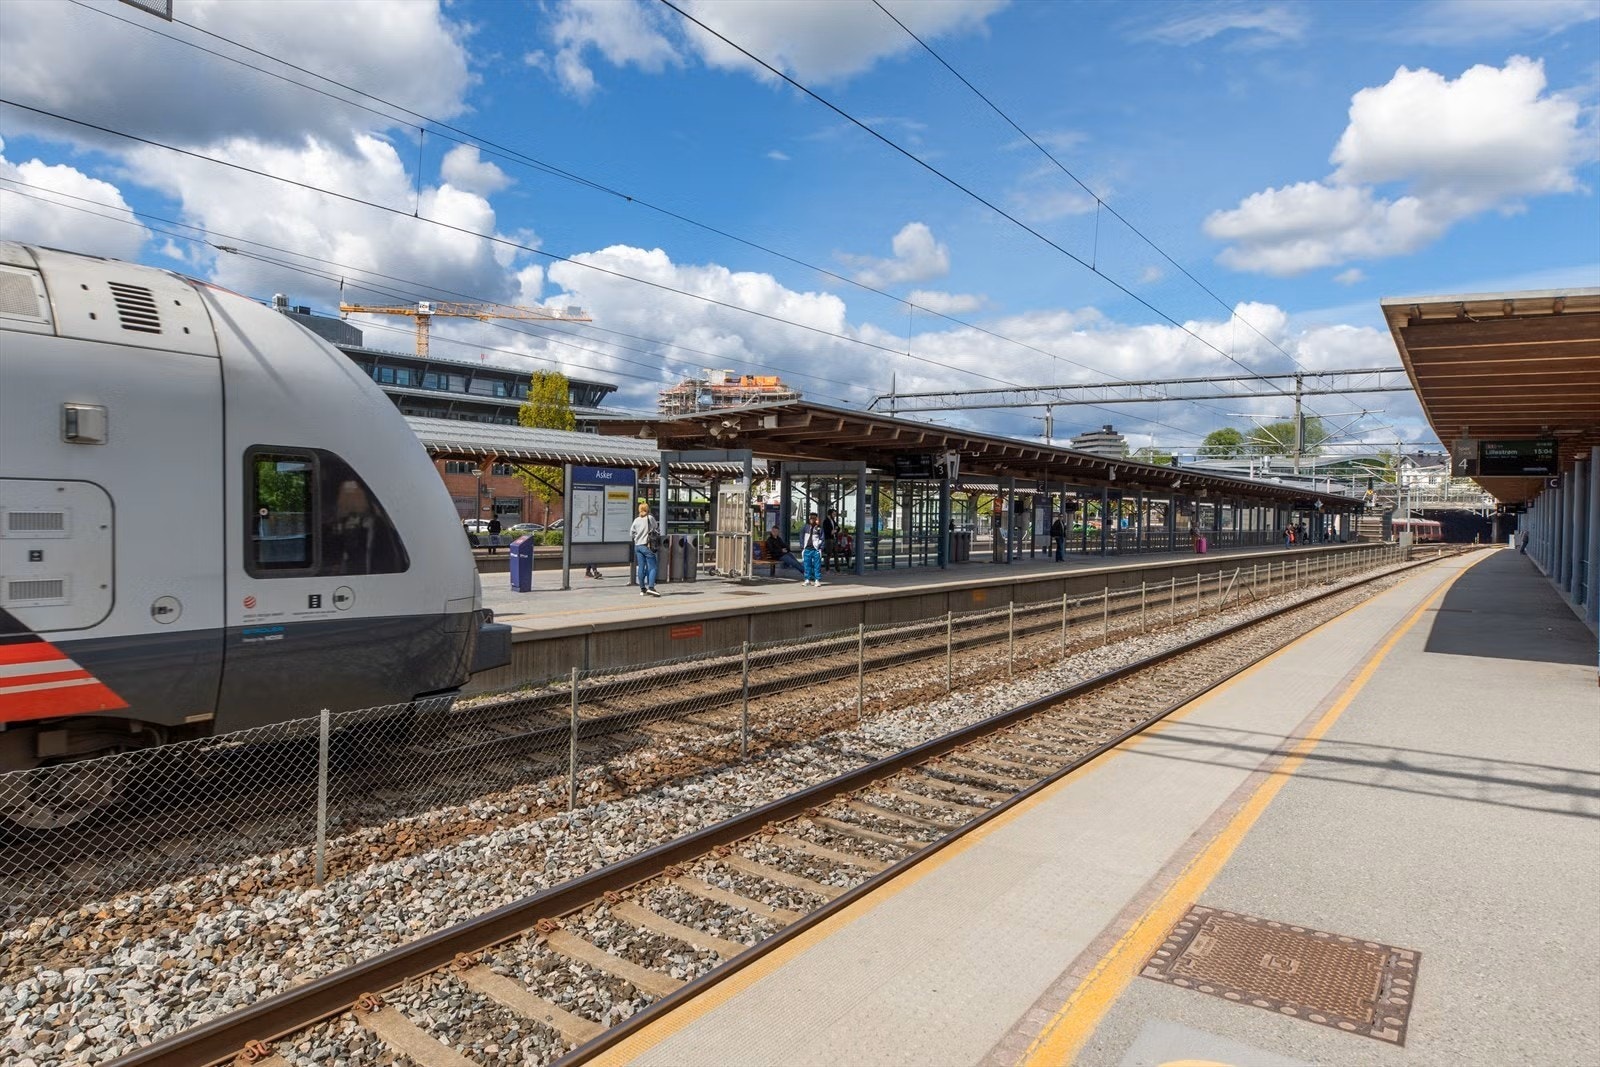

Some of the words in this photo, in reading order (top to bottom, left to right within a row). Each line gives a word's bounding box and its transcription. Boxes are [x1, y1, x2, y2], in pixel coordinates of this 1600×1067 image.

[1458, 458, 1469, 470] 4
[595, 470, 613, 480] Asker
[770, 466, 776, 475] 2
[938, 465, 944, 475] 3
[1550, 478, 1558, 488] C
